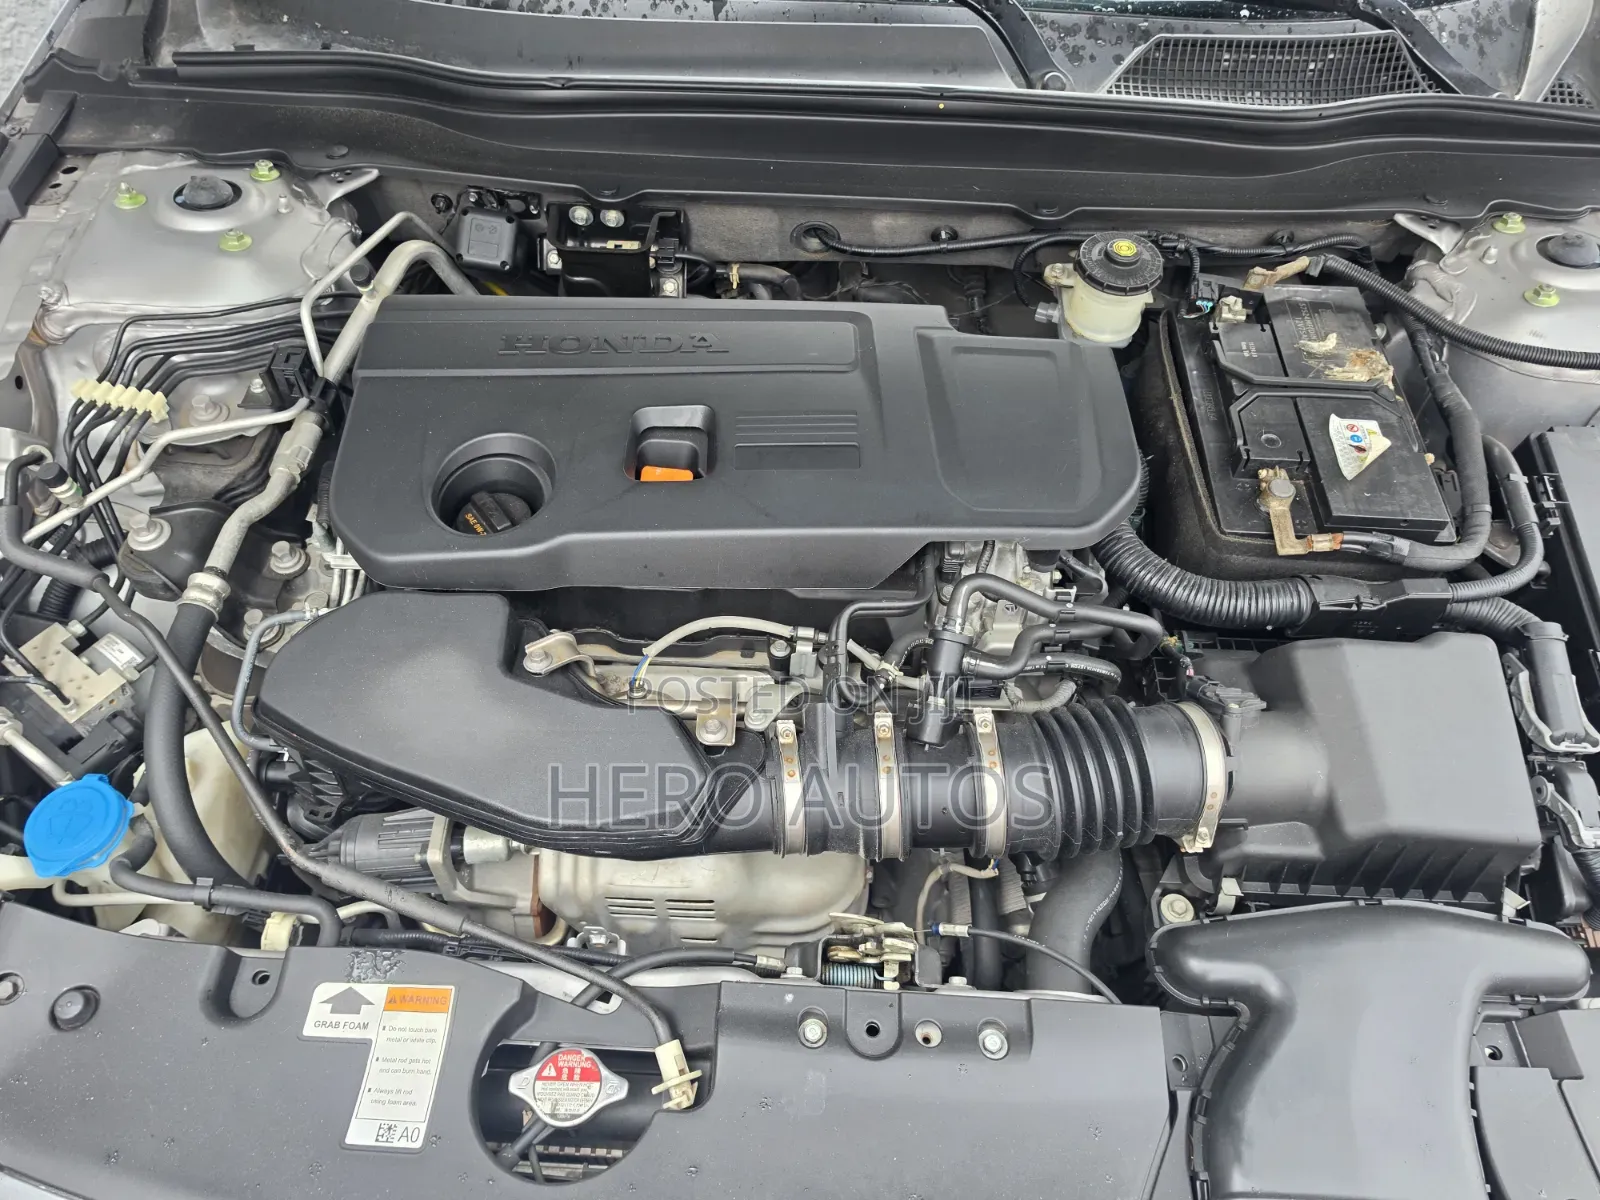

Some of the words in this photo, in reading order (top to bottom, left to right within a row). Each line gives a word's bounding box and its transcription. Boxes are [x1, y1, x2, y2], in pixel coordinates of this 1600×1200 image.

[497, 334, 730, 356] HONDA
[465, 512, 478, 525] SAE
[400, 994, 448, 1006] WARNING
[314, 1020, 340, 1030] GRAB
[342, 1021, 370, 1031] FOAM
[408, 1057, 420, 1065] gets
[421, 1057, 431, 1065] hot
[558, 1054, 586, 1062] DANGER
[558, 1060, 592, 1069] WARNUNG
[373, 1087, 394, 1095] Always
[370, 1098, 387, 1106] using
[397, 1126, 421, 1143] A0
